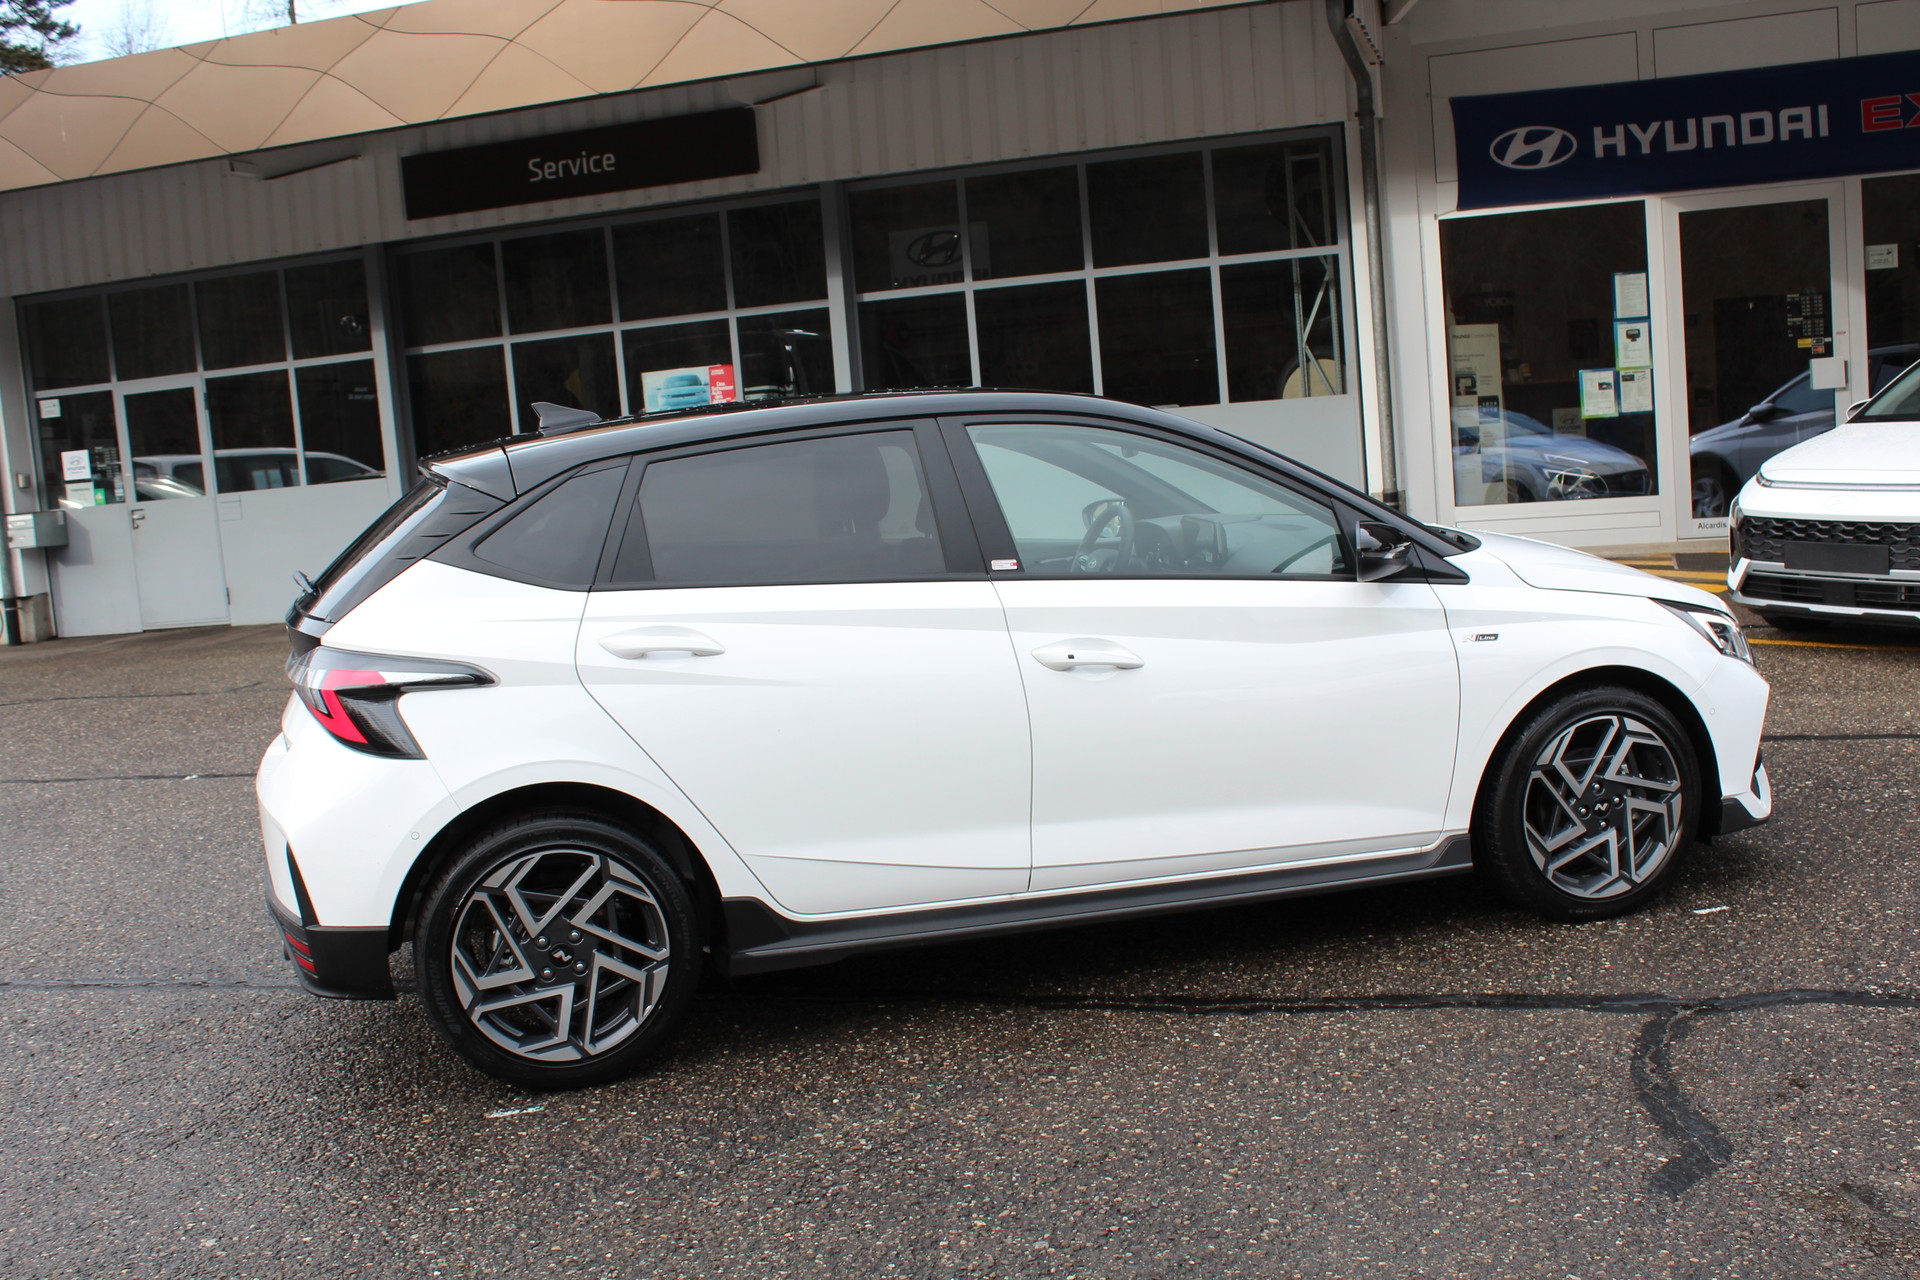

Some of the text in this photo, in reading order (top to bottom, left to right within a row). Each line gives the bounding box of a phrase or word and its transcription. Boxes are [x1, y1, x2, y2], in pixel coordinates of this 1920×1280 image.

[1593, 104, 1829, 158] HYUNDAI
[528, 151, 616, 182] Service
[1697, 521, 1727, 529] Alcardis
